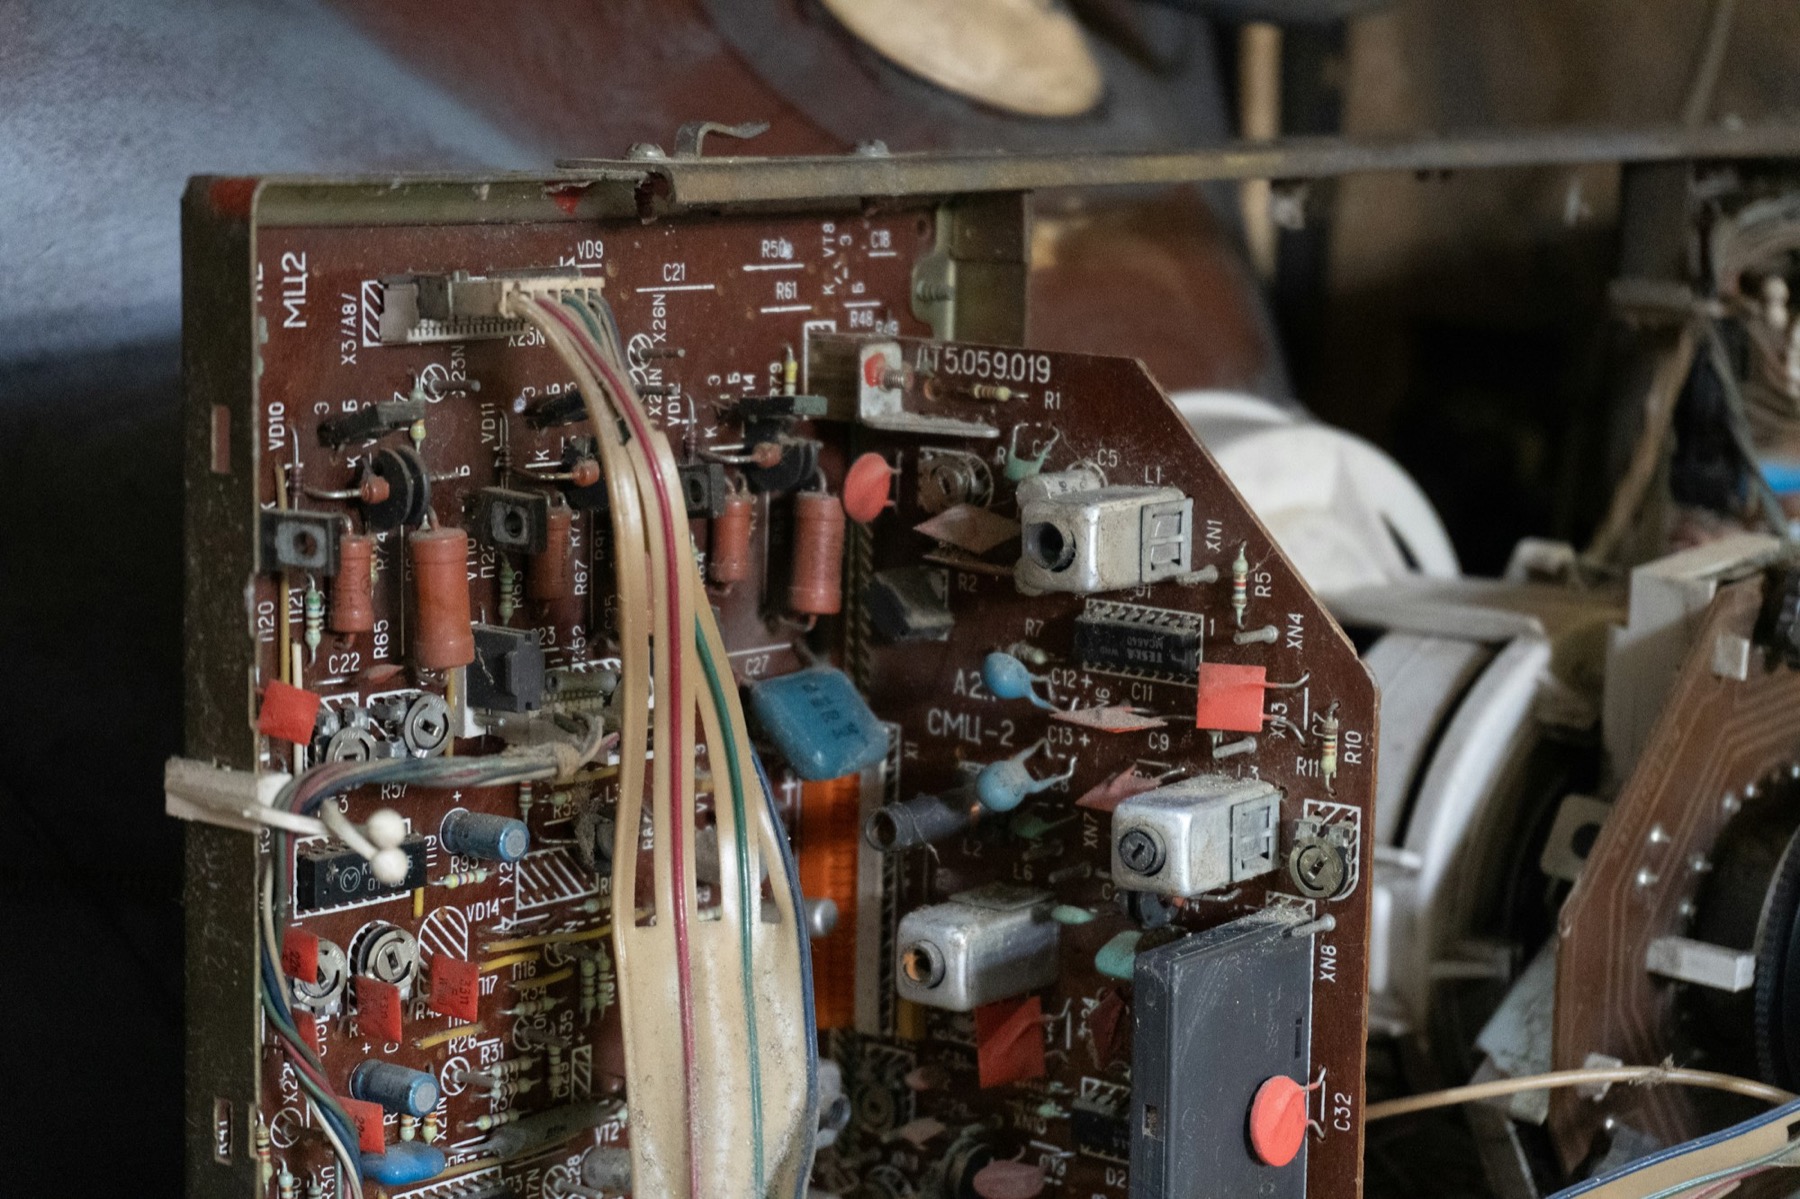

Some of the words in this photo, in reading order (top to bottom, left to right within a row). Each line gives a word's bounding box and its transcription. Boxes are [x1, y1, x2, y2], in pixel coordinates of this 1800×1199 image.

[577, 241, 604, 259] VD9
[664, 263, 685, 281] C21
[653, 292, 667, 344] X26N
[1043, 390, 1061, 410] R1
[268, 400, 286, 451] VD10
[480, 402, 496, 444] VD11
[1098, 449, 1119, 468] C5
[1145, 465, 1161, 484] L1
[1206, 519, 1223, 553] XN1
[574, 560, 588, 596] R67
[1254, 571, 1272, 598] R5
[1025, 618, 1045, 637] R7
[1286, 612, 1304, 650] XN4
[373, 619, 389, 660] R65
[328, 651, 361, 675] C22
[745, 654, 770, 677] C27
[1050, 667, 1077, 689] C12
[1131, 684, 1152, 702] C11
[1148, 731, 1170, 751] C9
[1344, 731, 1362, 764] R10
[1083, 813, 1099, 848] XN7
[466, 904, 500, 924] VD14
[1319, 944, 1337, 983] XN8
[449, 1037, 476, 1055] R26
[481, 1045, 504, 1065] R31
[1333, 1092, 1352, 1131] C32
